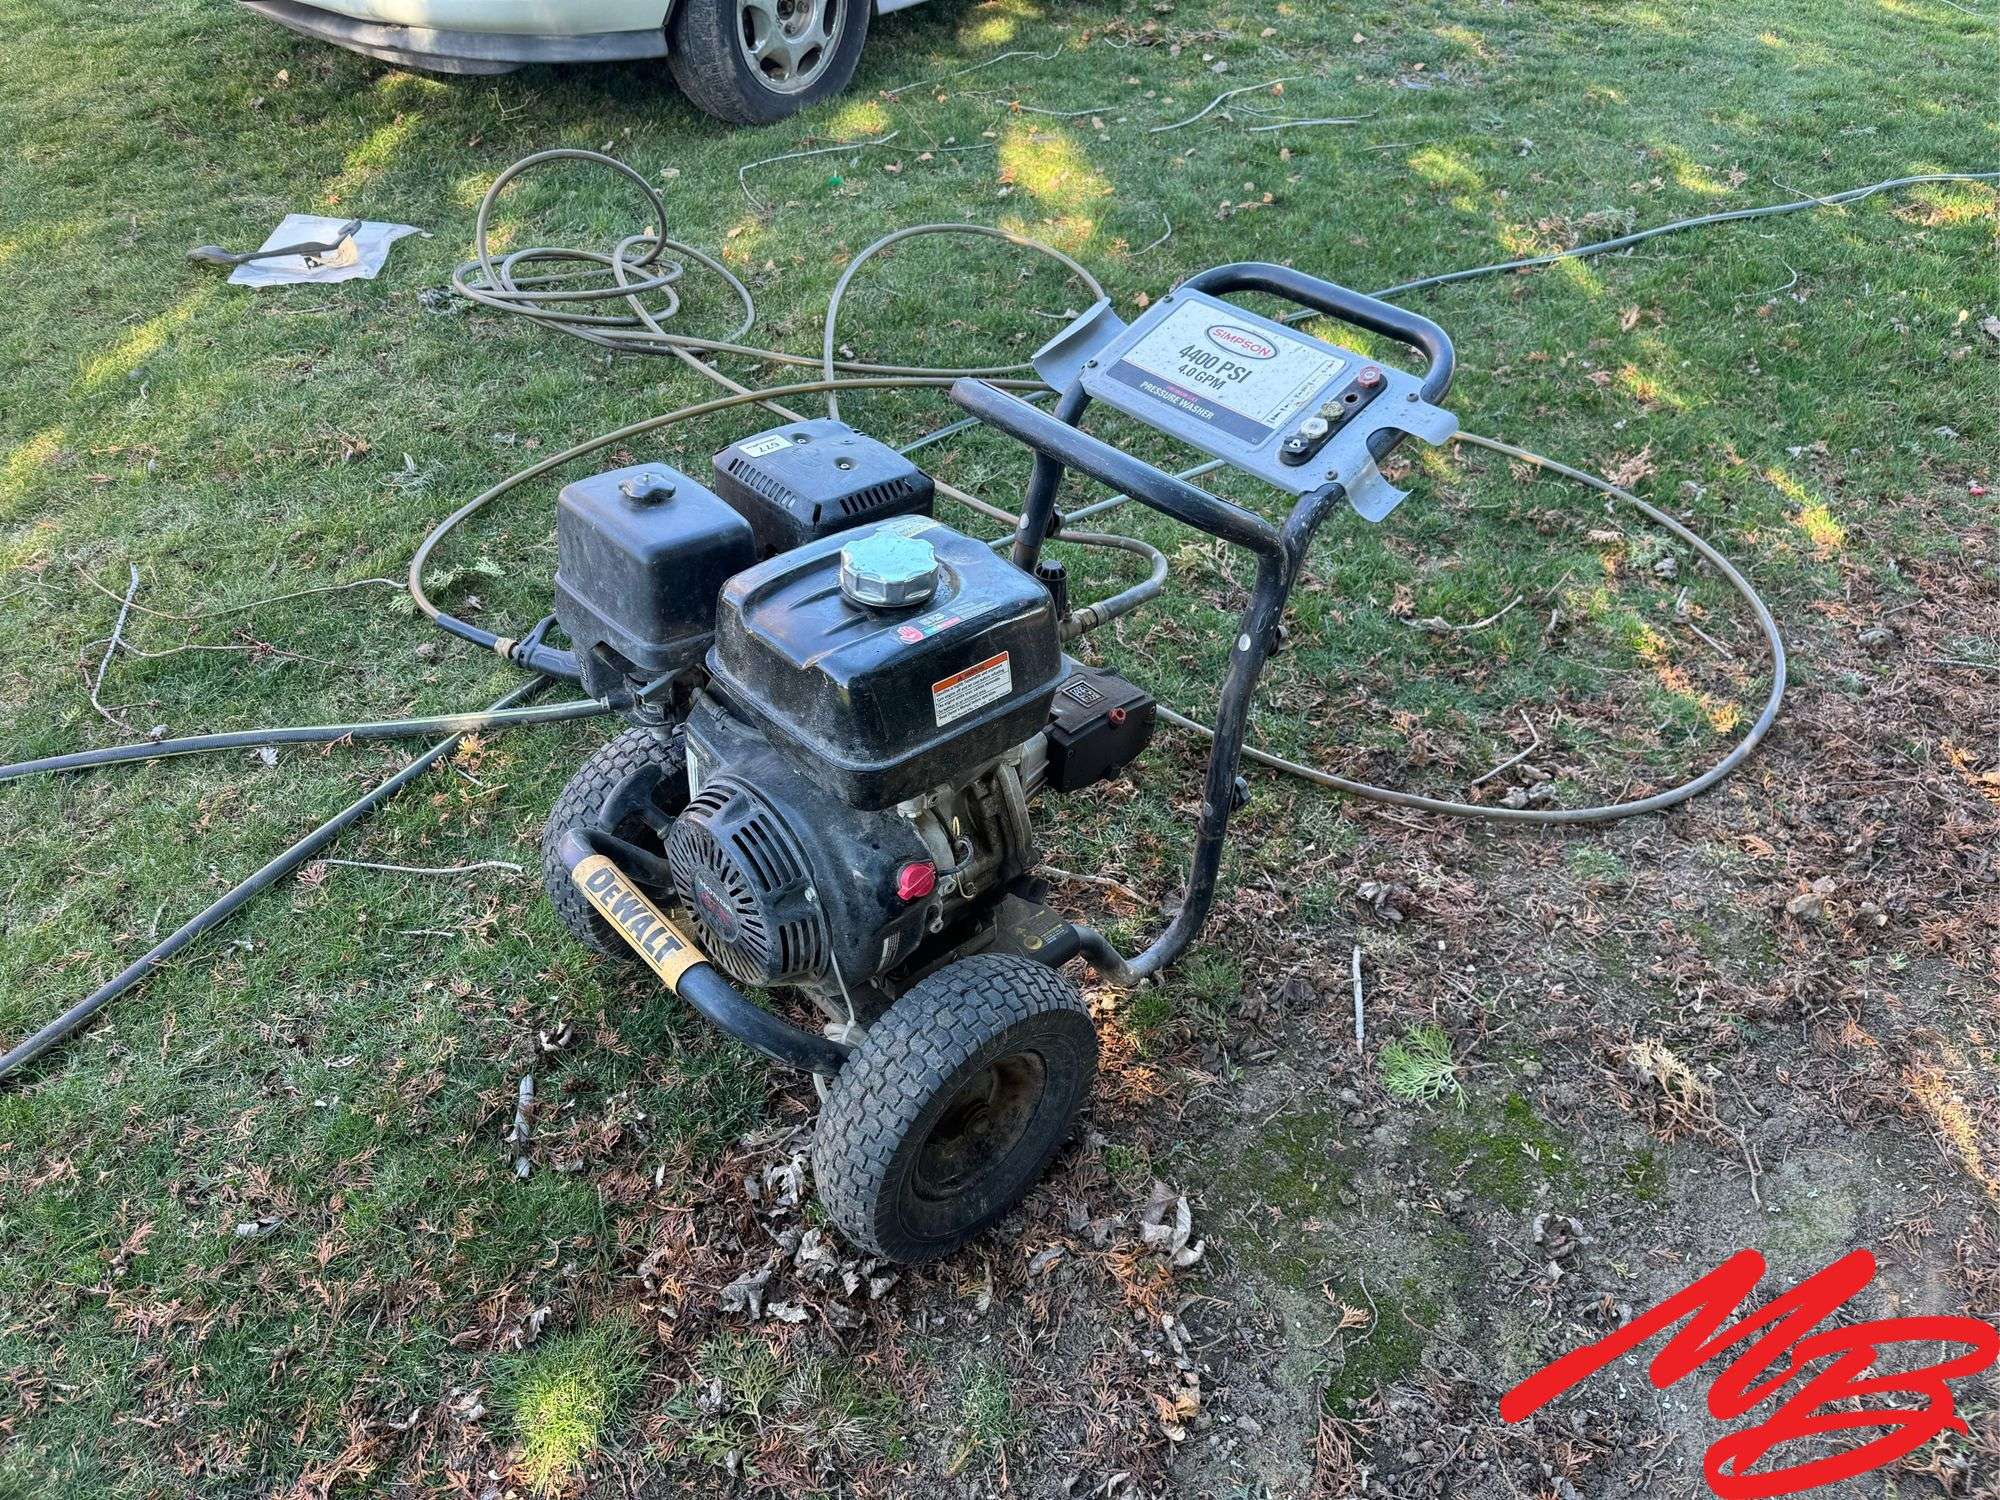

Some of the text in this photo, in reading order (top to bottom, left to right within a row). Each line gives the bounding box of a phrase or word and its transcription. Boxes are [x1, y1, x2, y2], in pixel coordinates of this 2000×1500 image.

[1213, 328, 1271, 356] SIMPSON
[1178, 364, 1227, 390] 4.0 GPM
[1179, 344, 1253, 383] 4400 PSI
[1139, 381, 1181, 404] PRESSURE
[1178, 397, 1216, 420] WASHER
